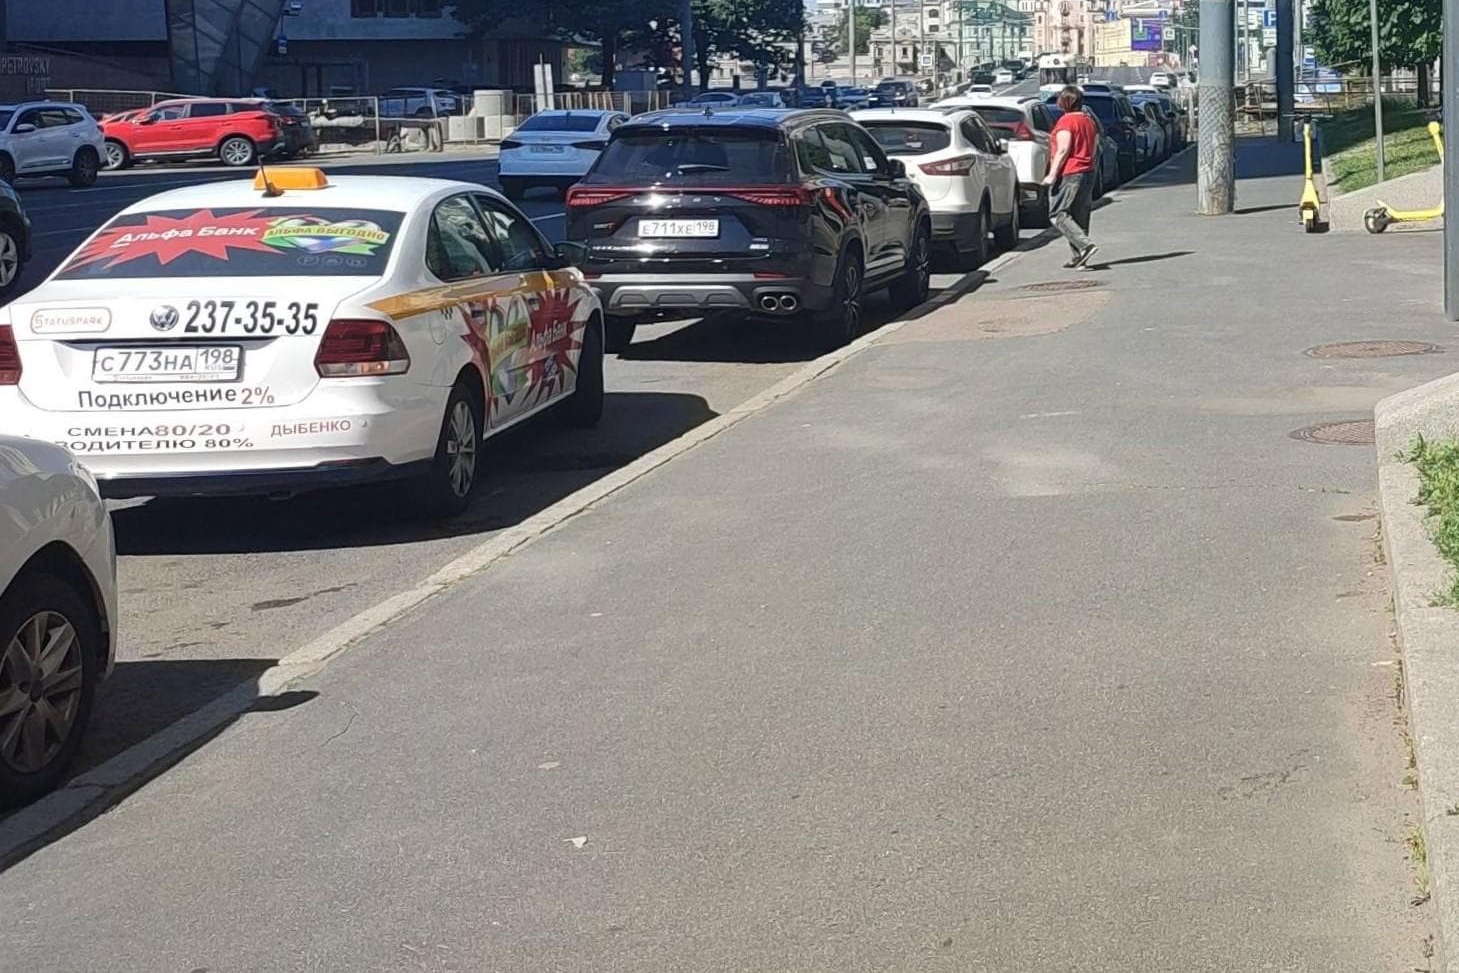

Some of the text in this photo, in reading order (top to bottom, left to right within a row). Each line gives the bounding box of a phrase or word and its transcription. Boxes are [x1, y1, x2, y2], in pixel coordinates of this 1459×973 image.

[112, 224, 259, 246] Альфа Банк
[184, 300, 319, 335] 237-35-35
[199, 348, 234, 365] 198
[77, 386, 275, 409] Подключение 2%
[270, 419, 352, 438] ДЫБЕНКО
[203, 437, 255, 449] 80%
